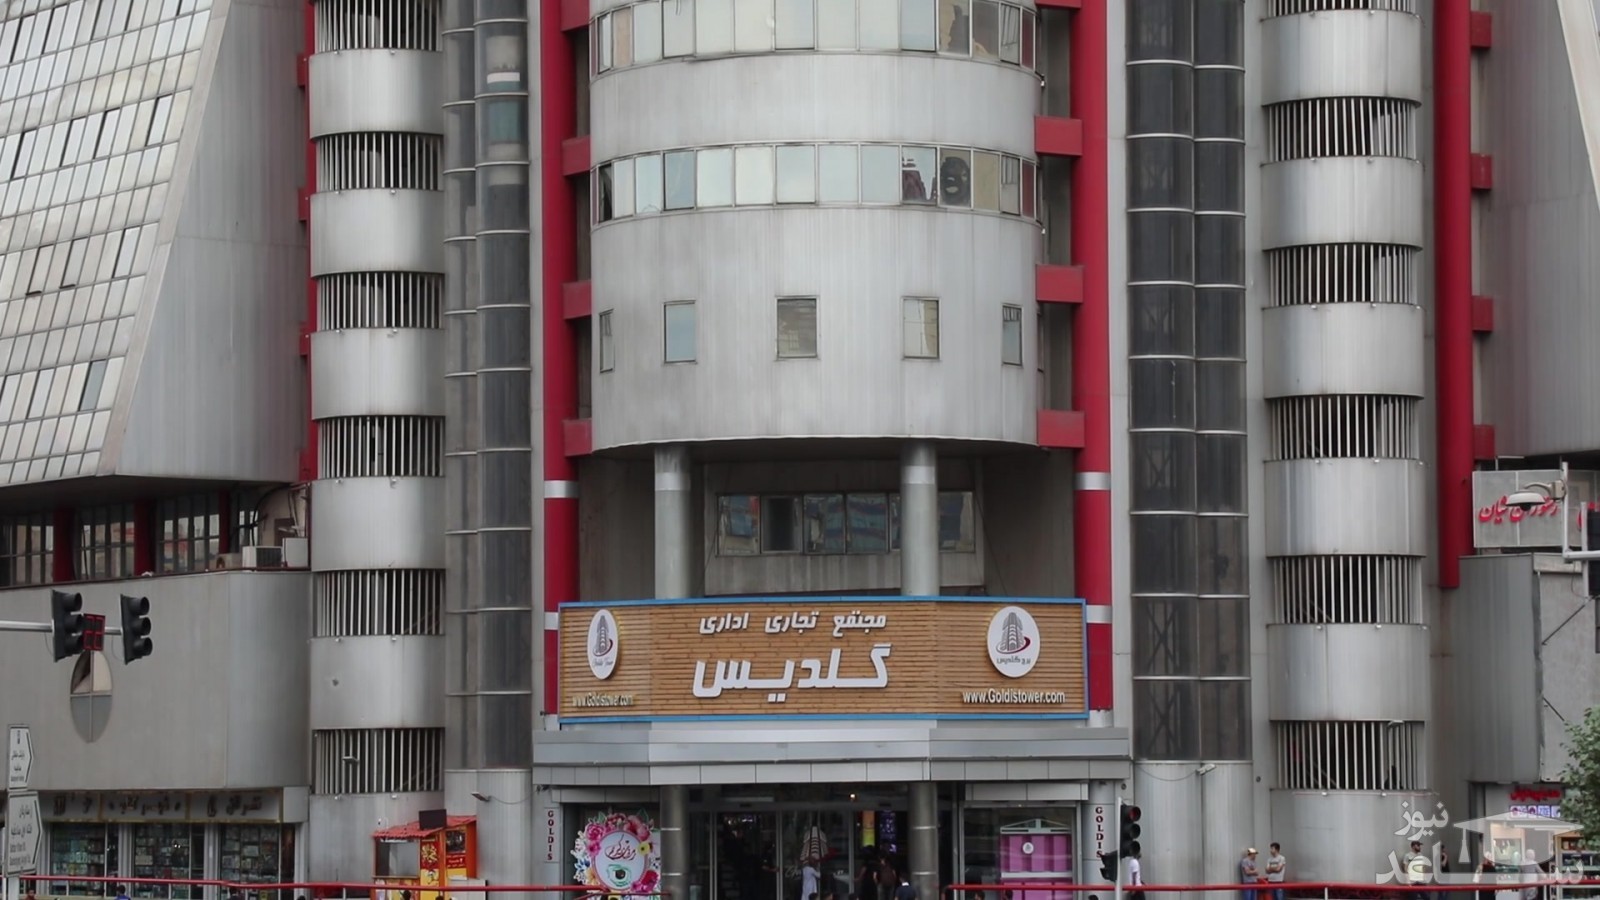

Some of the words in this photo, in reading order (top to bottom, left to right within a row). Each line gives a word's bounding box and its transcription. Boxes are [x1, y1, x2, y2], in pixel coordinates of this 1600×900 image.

[1510, 495, 1558, 523] رستورن
[699, 612, 750, 634] اداری
[764, 610, 820, 634] تجاری
[832, 609, 887, 637] مجتمع
[692, 643, 893, 702] گلدیس
[996, 655, 1021, 665] گلدیس
[962, 687, 1066, 704] www.Goldistower.com
[547, 809, 555, 861] GOLDIS
[1094, 805, 1105, 859] GOLDIS
